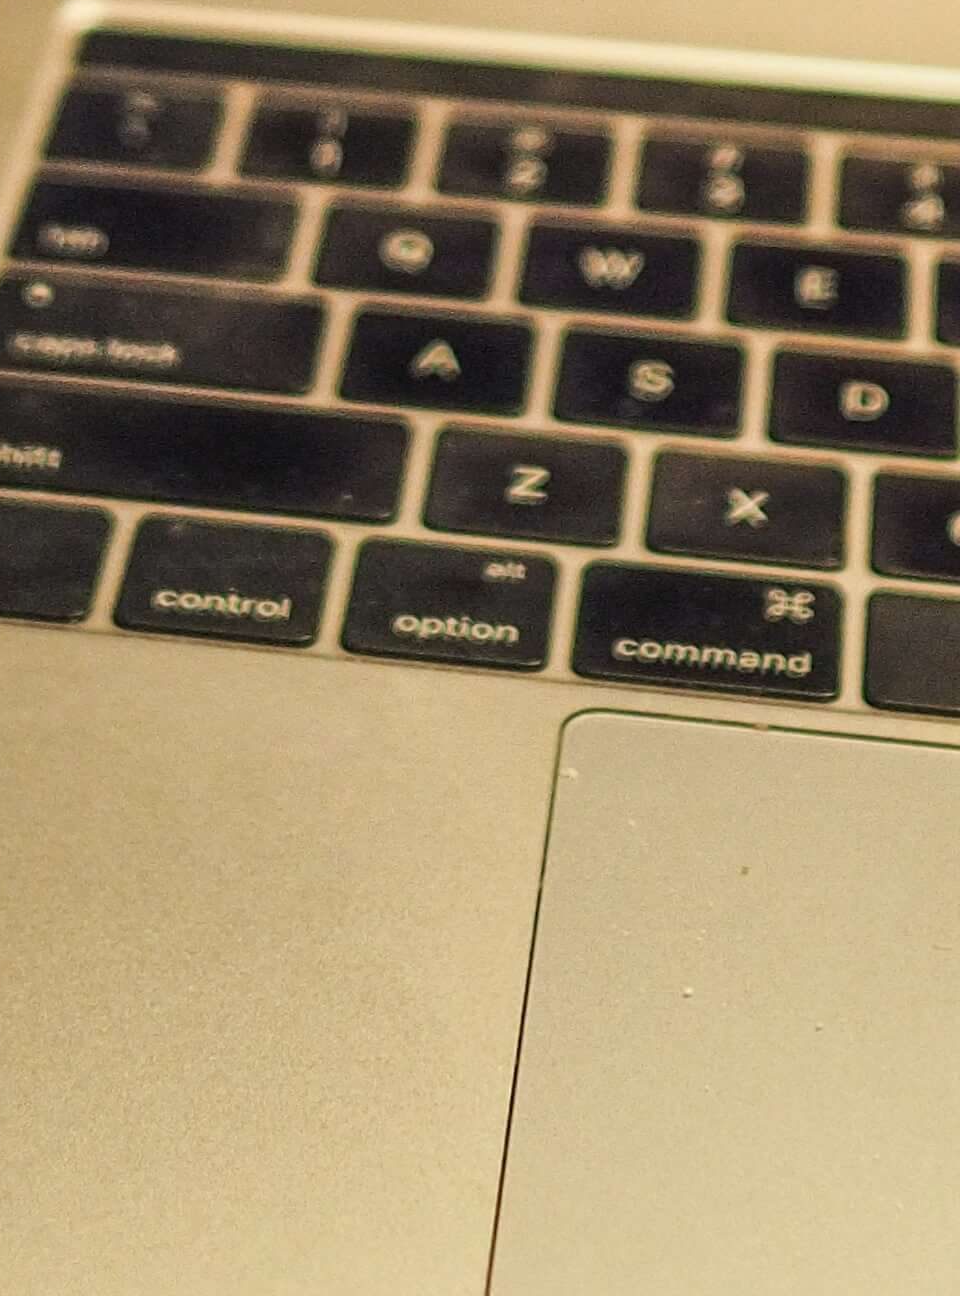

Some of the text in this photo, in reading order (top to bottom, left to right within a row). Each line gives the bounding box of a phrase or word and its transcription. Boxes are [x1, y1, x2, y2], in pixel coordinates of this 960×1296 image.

[581, 248, 644, 288] W
[794, 266, 839, 307] E
[413, 341, 461, 377] A
[631, 361, 674, 399] S
[841, 381, 889, 418] D
[507, 465, 551, 503] Z
[726, 487, 770, 526] X
[484, 560, 527, 581] alt
[153, 587, 291, 619] control
[393, 614, 519, 643] option
[613, 638, 812, 677] command
